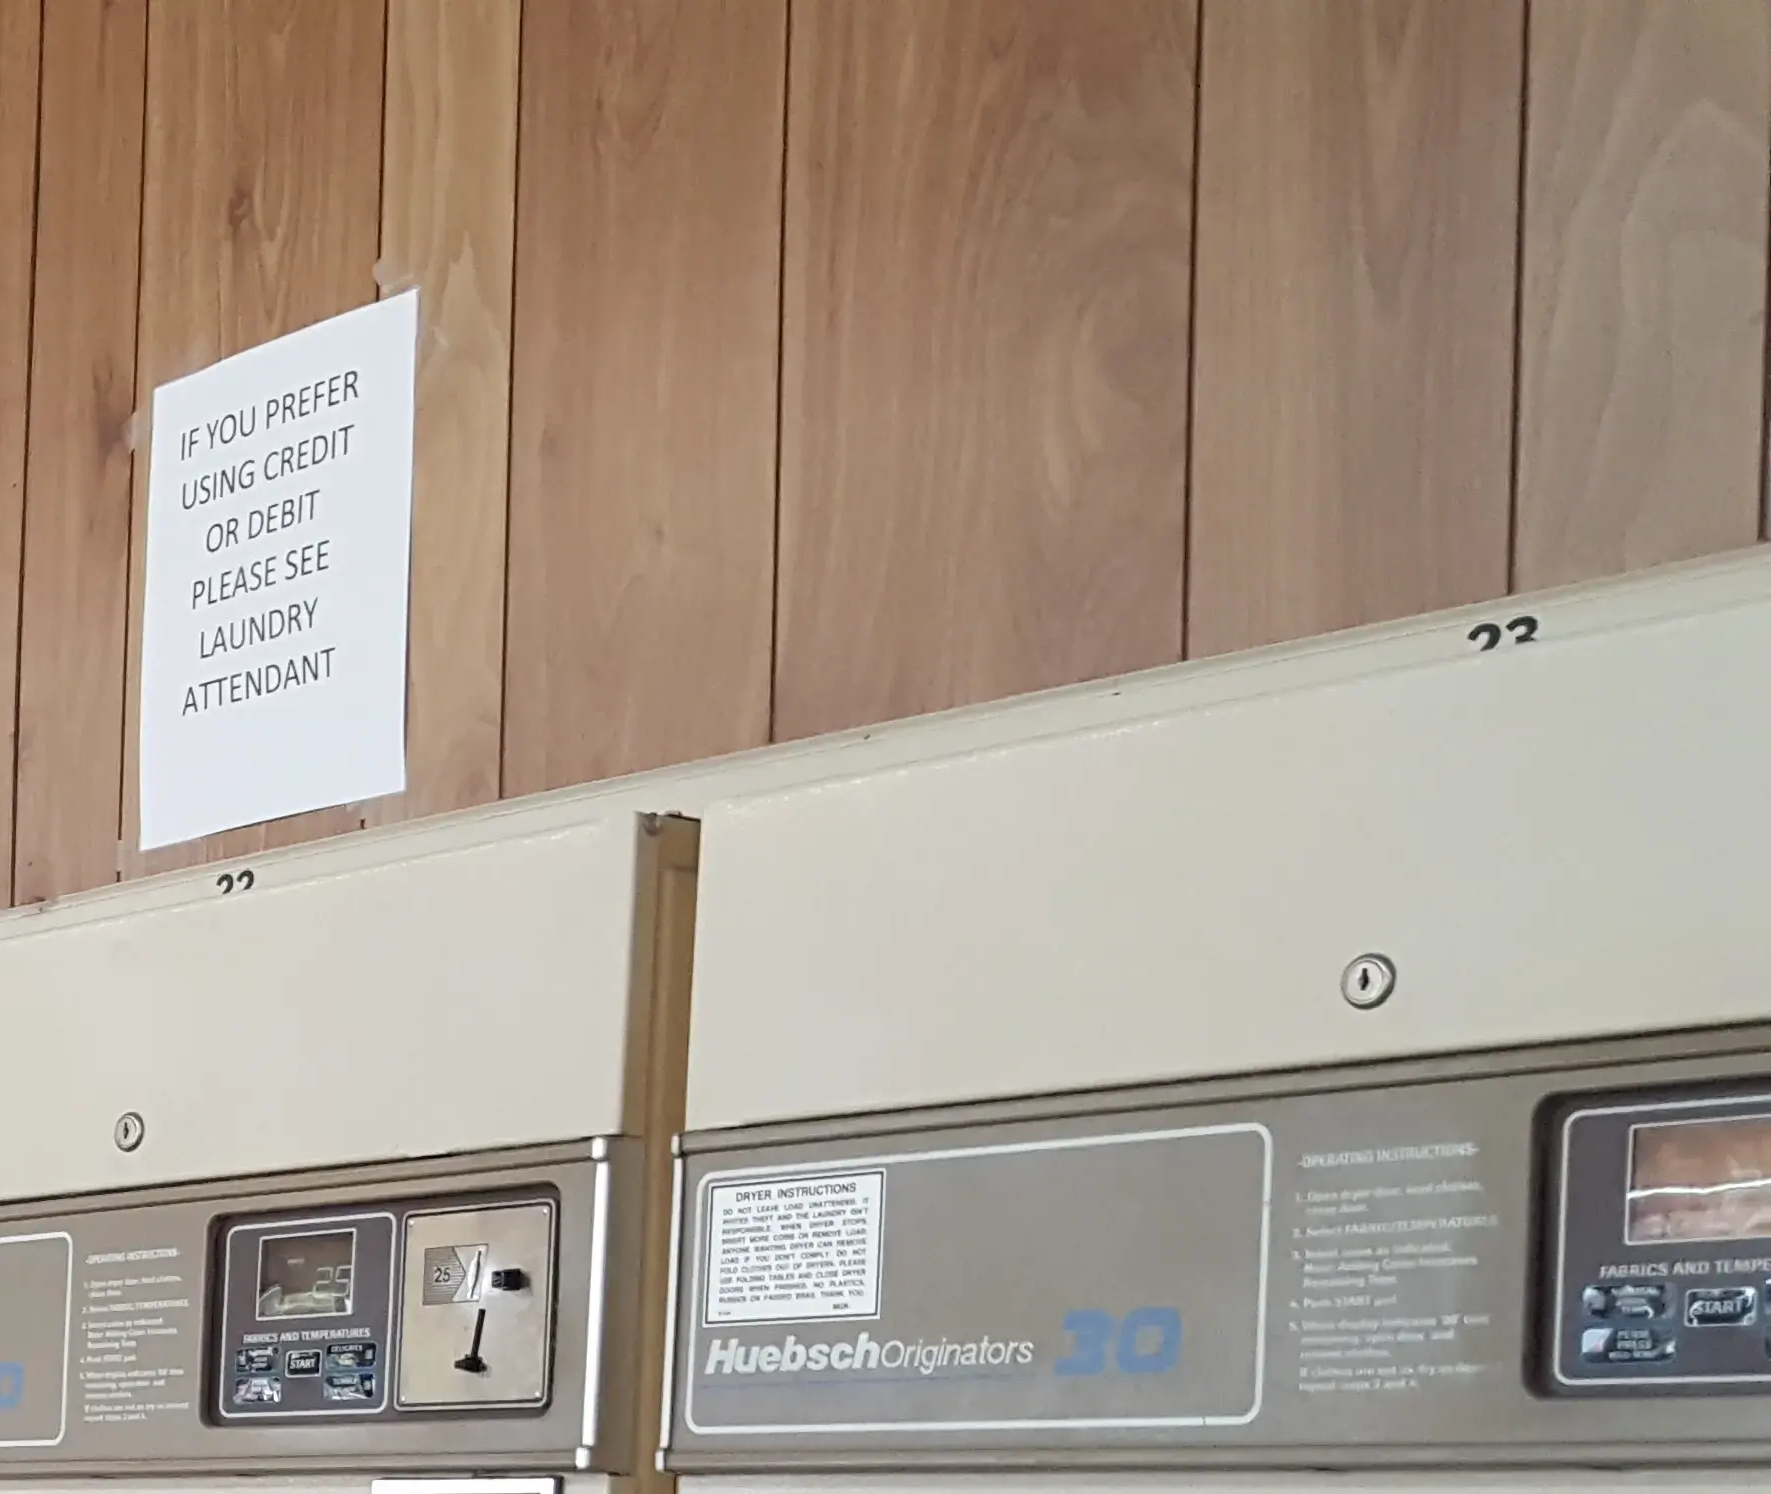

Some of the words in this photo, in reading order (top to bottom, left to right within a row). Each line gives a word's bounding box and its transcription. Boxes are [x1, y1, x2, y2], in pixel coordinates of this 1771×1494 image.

[181, 429, 200, 462] IF
[206, 405, 257, 449] YOU
[265, 370, 359, 430] PREFER
[181, 460, 255, 510] USING
[264, 425, 355, 481] CREDIT
[205, 521, 238, 554] OR
[248, 490, 321, 535] DEBIT
[192, 556, 277, 610] PLEASE
[284, 540, 330, 579] SEE
[200, 598, 318, 660] LAUNDRY
[182, 647, 336, 716] ATTENDANT
[736, 1190, 771, 1202] DRYER
[777, 1182, 857, 1199] INSTRUCTIONS
[434, 1267, 451, 1282] 25
[1599, 1262, 1669, 1280] FABRICS
[1672, 1260, 1711, 1276] AND
[1691, 1299, 1744, 1315] START
[290, 1358, 316, 1370] START
[1053, 1306, 1184, 1376] 30
